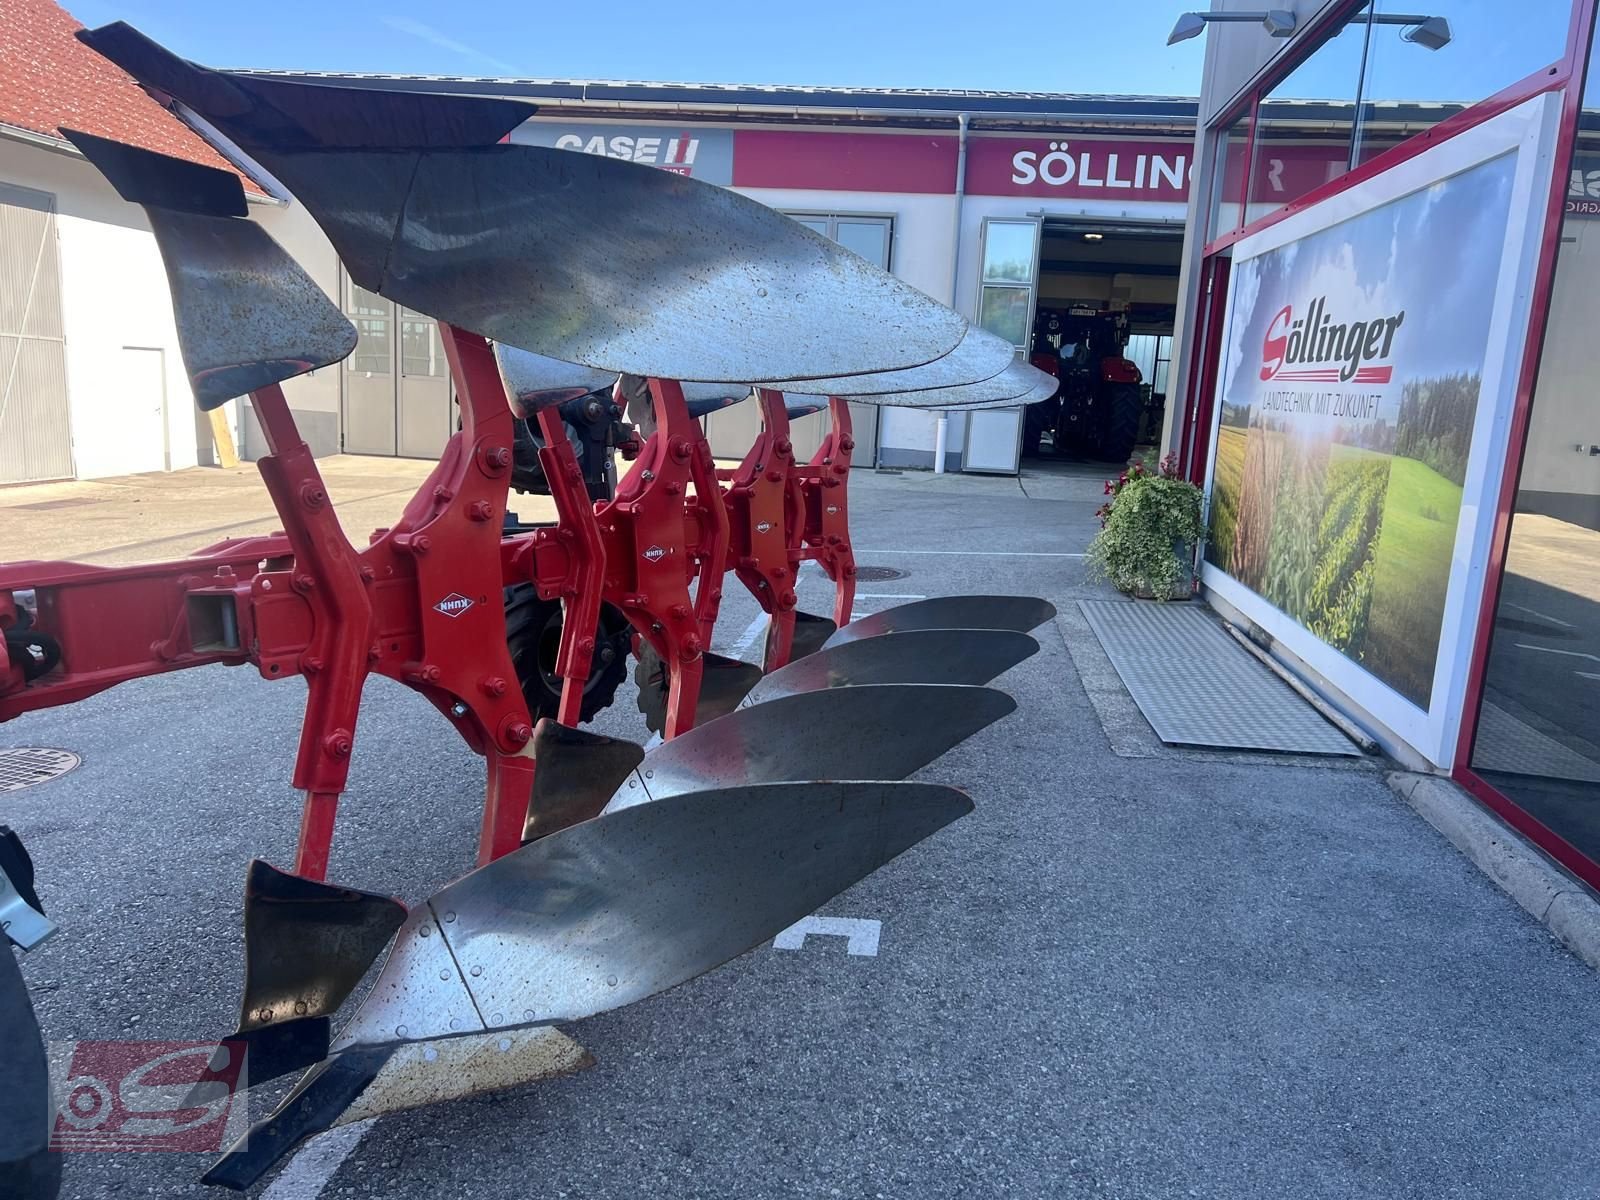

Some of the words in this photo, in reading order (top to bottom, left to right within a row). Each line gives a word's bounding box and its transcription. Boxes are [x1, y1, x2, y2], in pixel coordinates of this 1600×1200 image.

[555, 134, 661, 163] CASE
[1012, 142, 1193, 190] SÖLLIN
[1259, 296, 1405, 382] Söllinger
[1262, 391, 1314, 414] LANDTECHNIK
[1314, 392, 1333, 416] MIT
[1332, 393, 1382, 419] ZUKUNFT
[440, 598, 468, 610] KUHN
